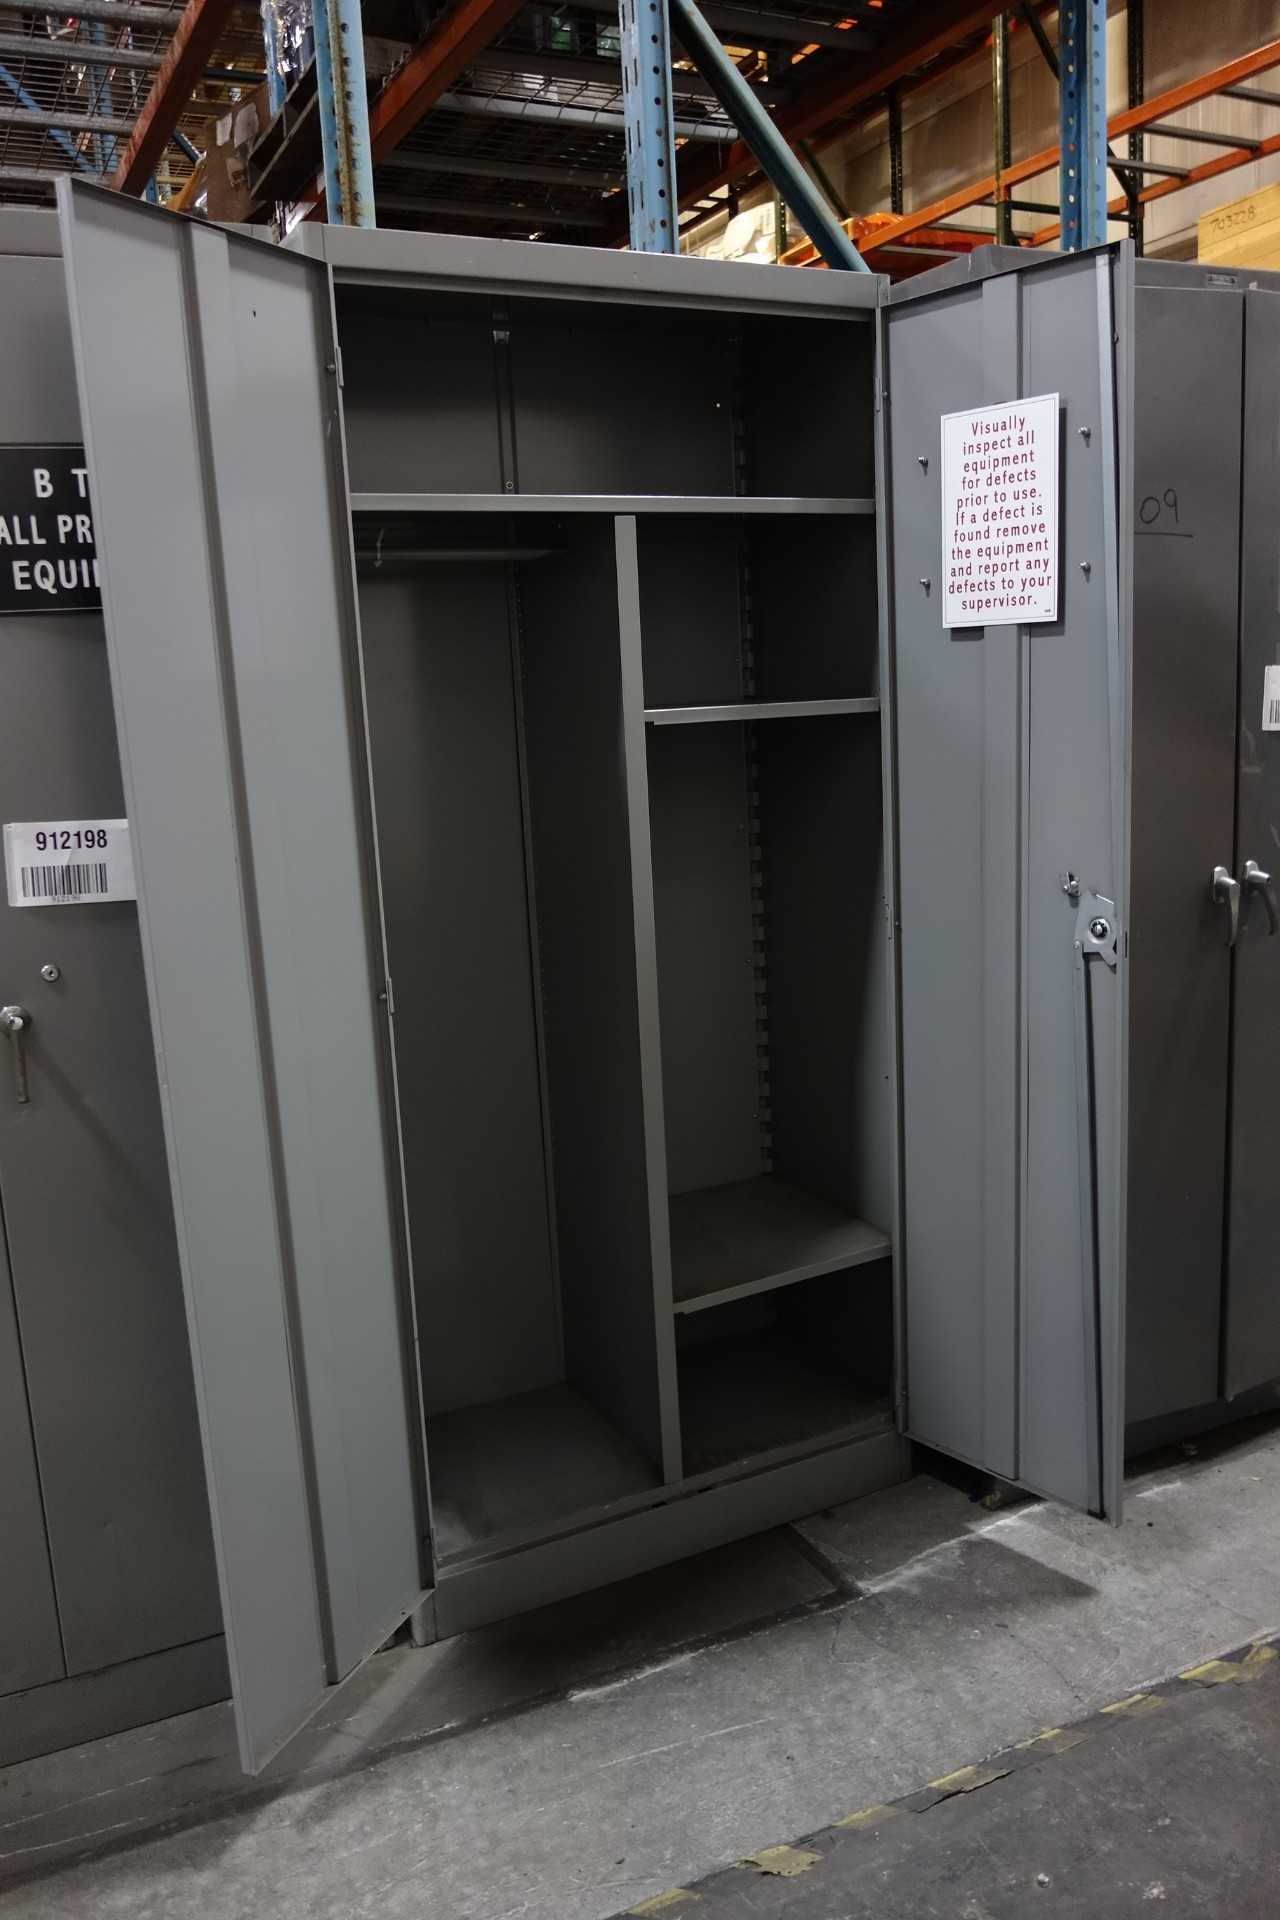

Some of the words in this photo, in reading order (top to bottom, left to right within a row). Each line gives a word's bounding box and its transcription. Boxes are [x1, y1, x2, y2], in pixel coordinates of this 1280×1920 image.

[971, 414, 1026, 437] Visually
[963, 435, 1012, 456] inspect
[1017, 429, 1035, 446] all
[963, 449, 1035, 475] equipment
[33, 468, 54, 498] B
[962, 476, 981, 491] for
[986, 467, 1037, 487] defects
[957, 493, 989, 512] prior
[994, 490, 1007, 503] to
[1013, 487, 1042, 501] use.
[955, 511, 965, 526] If
[970, 513, 977, 524] a
[982, 504, 1025, 522] defect
[1031, 502, 1043, 516] is
[0, 514, 47, 546] ALL
[954, 526, 990, 543] found
[996, 521, 1046, 538] remove
[951, 546, 971, 561] the
[977, 537, 1049, 560] equipment
[950, 562, 972, 577] and
[978, 558, 1020, 577] report
[1025, 557, 1050, 573] any
[948, 579, 996, 594] defects
[1001, 576, 1014, 590] to
[1020, 575, 1052, 592] your
[961, 593, 1037, 613] supervisor.
[35, 829, 108, 851] 912198
